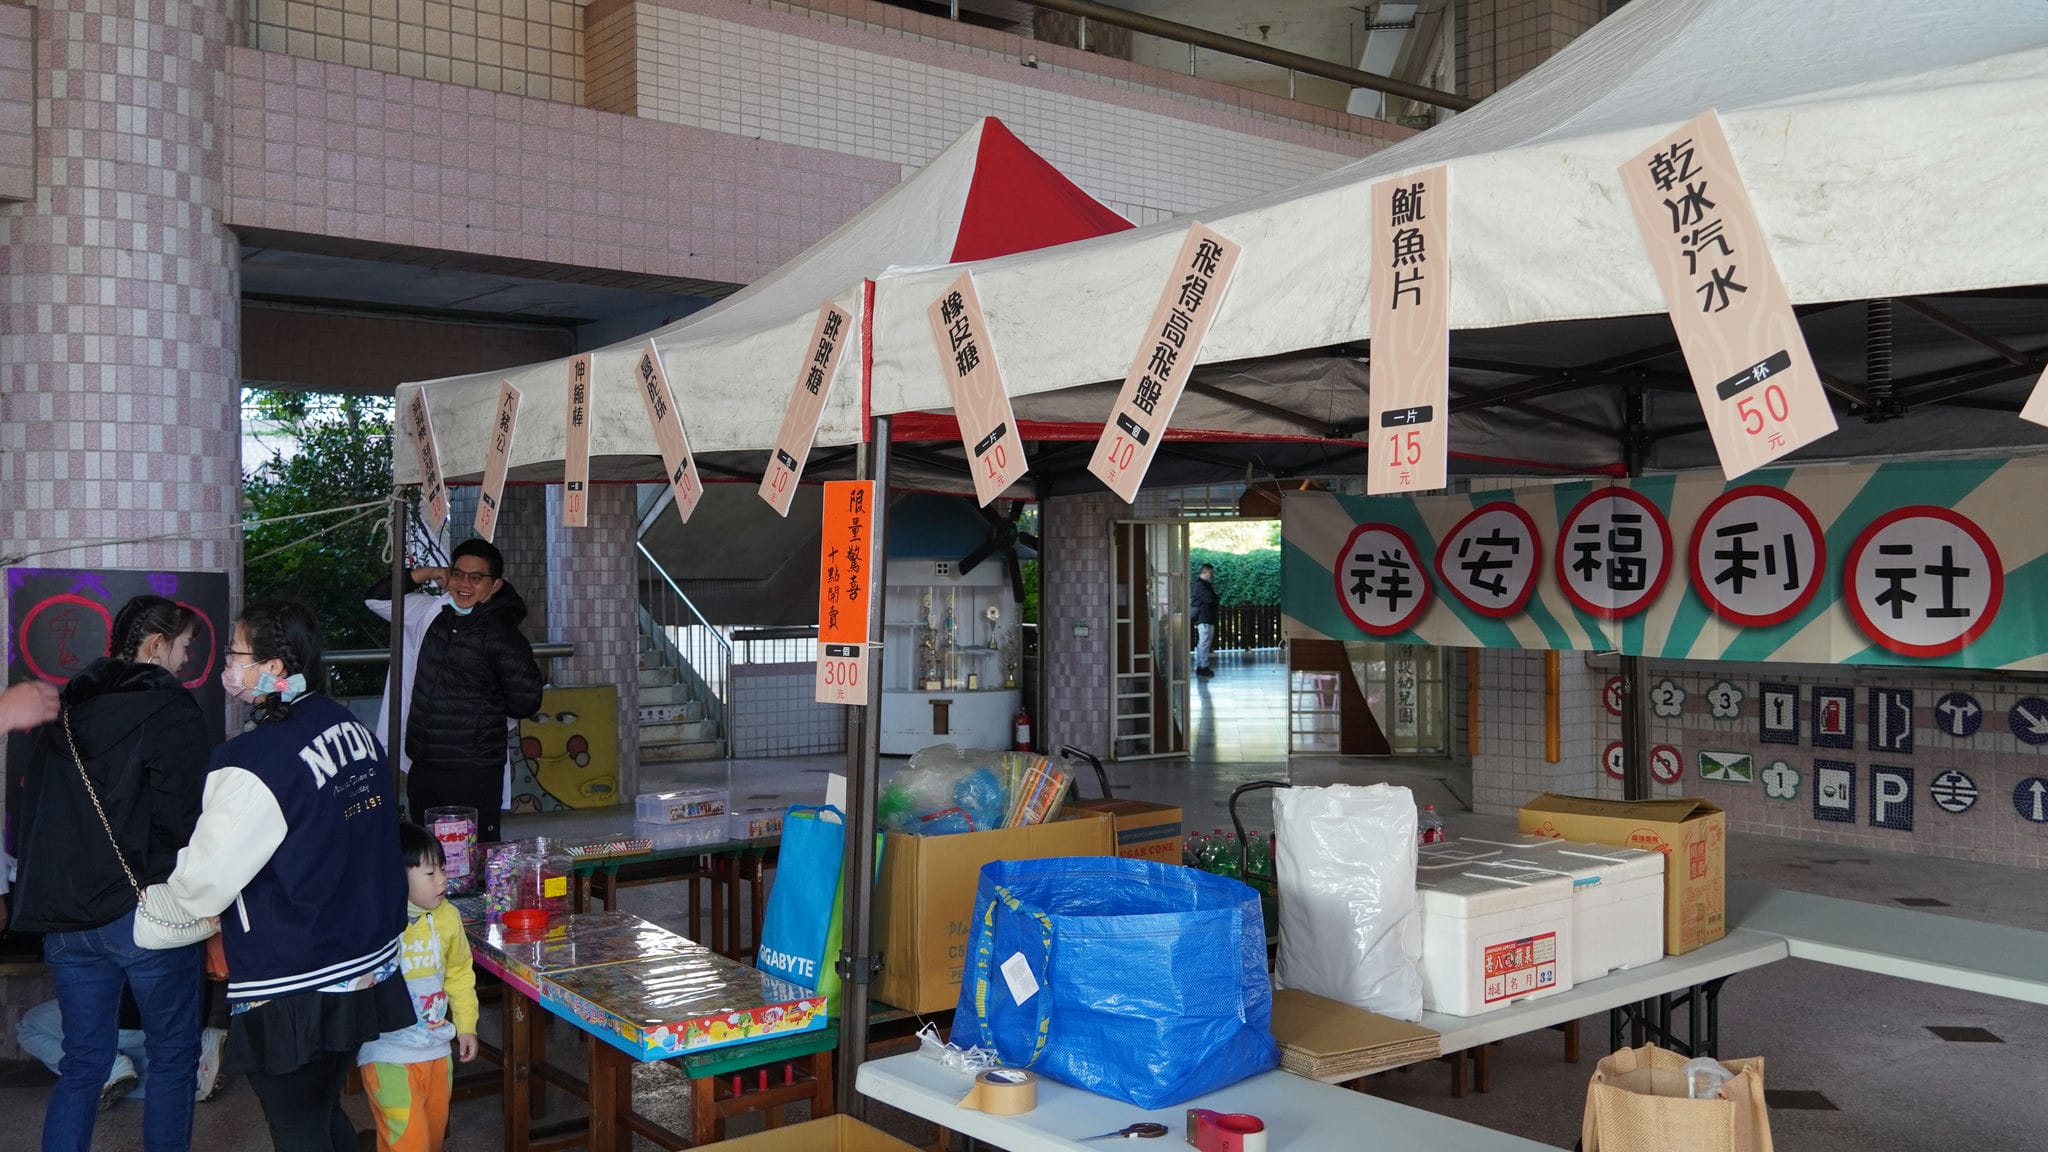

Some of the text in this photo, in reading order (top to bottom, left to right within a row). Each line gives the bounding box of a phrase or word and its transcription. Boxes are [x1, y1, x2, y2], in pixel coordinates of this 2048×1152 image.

[1648, 138, 1748, 313] 乾冰汽水
[1391, 182, 1426, 310] 魷魚片
[940, 290, 980, 378] 橡皮糖
[1132, 238, 1223, 417] 飛得高飛盤
[805, 310, 843, 396] 跳跳糖
[1734, 361, 1770, 387] 一杯
[572, 360, 585, 427] 伸縮棒
[497, 391, 514, 454] 大豬公
[1393, 409, 1418, 424] 一片
[1736, 384, 1789, 436] 50
[982, 432, 997, 448] 一片
[1108, 436, 1134, 471] 10
[1389, 430, 1421, 467] 15
[1767, 431, 1785, 451] 元
[984, 444, 1006, 479] 10
[680, 473, 692, 500] 10
[771, 466, 788, 493] 10
[997, 475, 1006, 485] 元
[1107, 470, 1116, 482] 元
[1399, 471, 1411, 485] 元
[481, 506, 491, 526] 15
[568, 495, 580, 513] 10
[847, 489, 866, 601] 限量驚喜
[1350, 513, 1971, 620] 祥安福利社
[826, 546, 841, 630] 十點開賣
[824, 660, 858, 687] 300
[837, 690, 846, 700] 元
[1663, 690, 1674, 706] 2
[1719, 693, 1731, 710] 3
[1776, 772, 1783, 789] 1
[1876, 773, 1909, 823] P
[1149, 842, 1175, 855] CONE
[1540, 970, 1552, 983] 32
